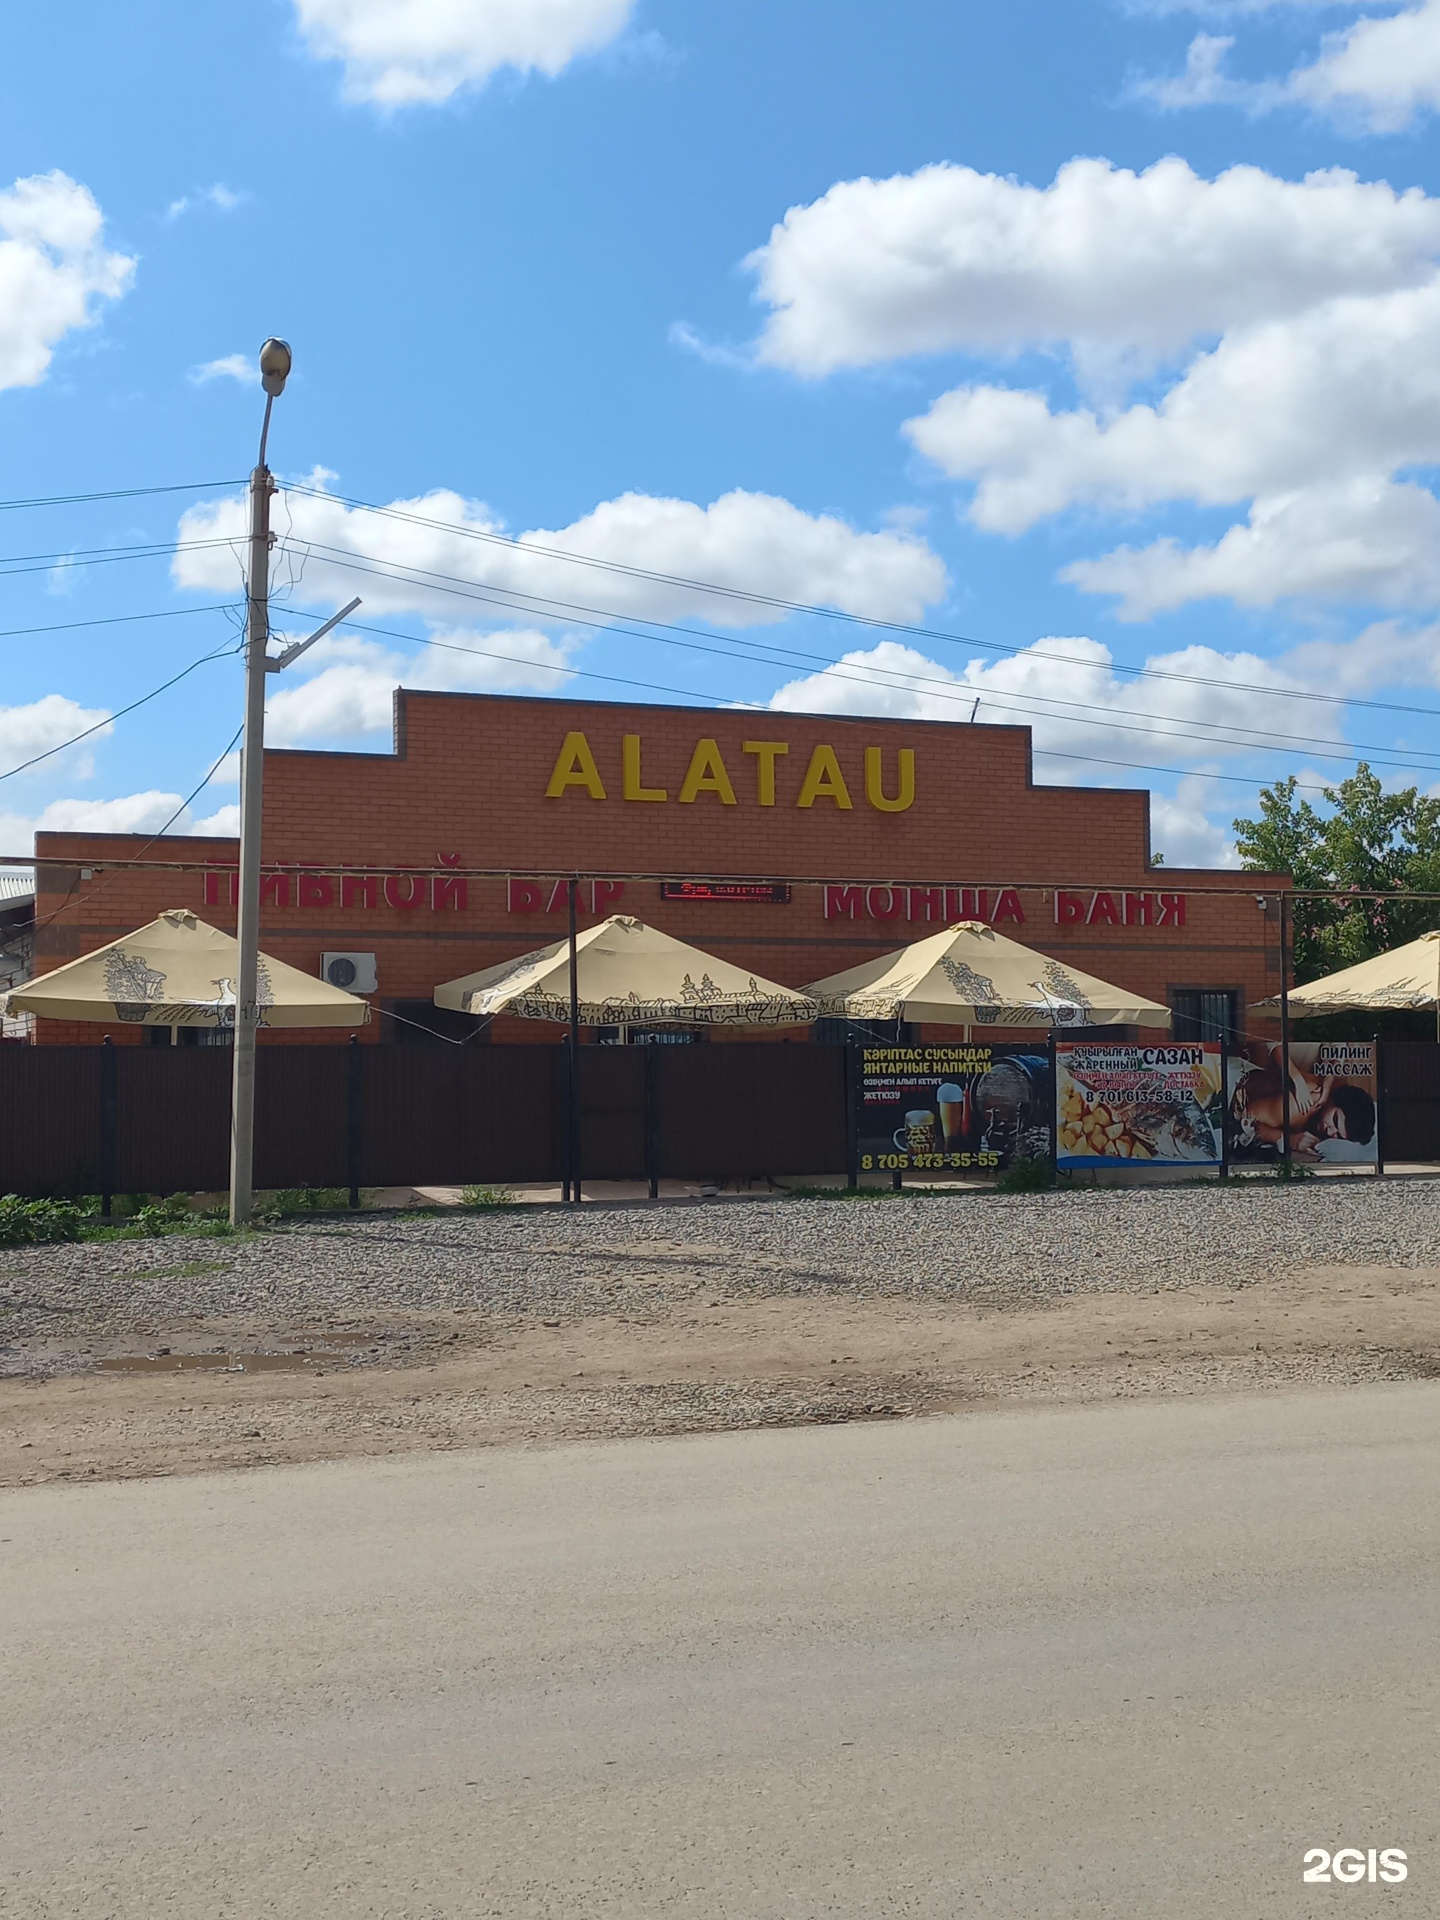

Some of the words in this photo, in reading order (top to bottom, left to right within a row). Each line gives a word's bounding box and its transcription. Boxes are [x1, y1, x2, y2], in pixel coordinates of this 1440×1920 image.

[545, 731, 915, 812] ALATAU
[203, 853, 468, 912] ПИВНОЙ
[507, 868, 626, 913] БАР
[823, 884, 1026, 924] МОНША
[1053, 889, 1186, 926] БАНЯ
[863, 1048, 922, 1060] КӘРІПТАС
[925, 1048, 992, 1061] СУСЫНДАР
[1142, 1048, 1203, 1065] САЗАН
[1321, 1047, 1372, 1059] ПИЛИНГ
[863, 1062, 930, 1074] ЯНТАРНЫЕ
[933, 1061, 992, 1073] НАПИТКИ
[1074, 1058, 1137, 1070] ЖАРЕННЫЙ
[1314, 1063, 1372, 1075] МАССАЖ
[1085, 1091, 1094, 1103] 8
[1099, 1091, 1121, 1102] 701
[1126, 1090, 1193, 1102] 613-58-12
[861, 1154, 873, 1169] 8
[877, 1154, 909, 1168] 705
[913, 1152, 999, 1168] 473-35-55
